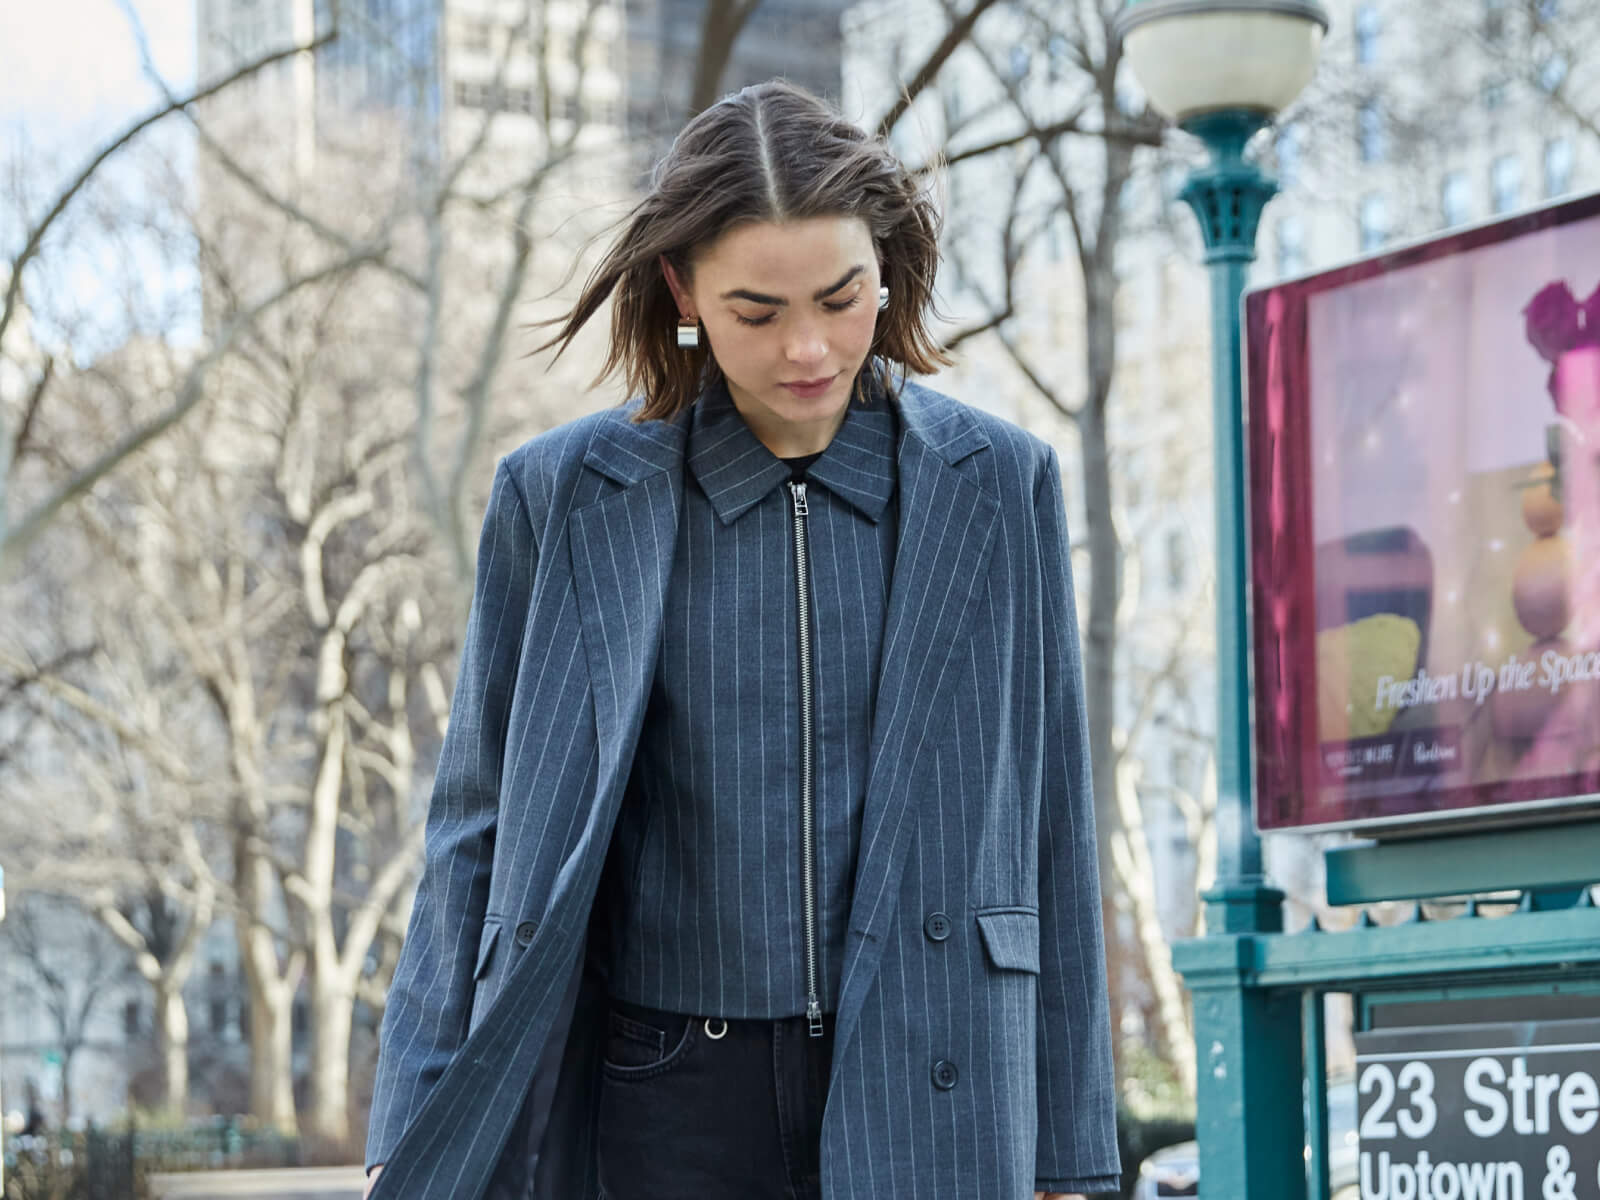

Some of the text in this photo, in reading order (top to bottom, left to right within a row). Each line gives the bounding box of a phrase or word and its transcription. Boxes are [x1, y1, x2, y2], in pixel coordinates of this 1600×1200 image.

[1375, 668, 1458, 711] Freshen
[1461, 662, 1495, 705] Up
[1498, 655, 1536, 692] the
[1359, 1057, 1600, 1139] 23 Stre
